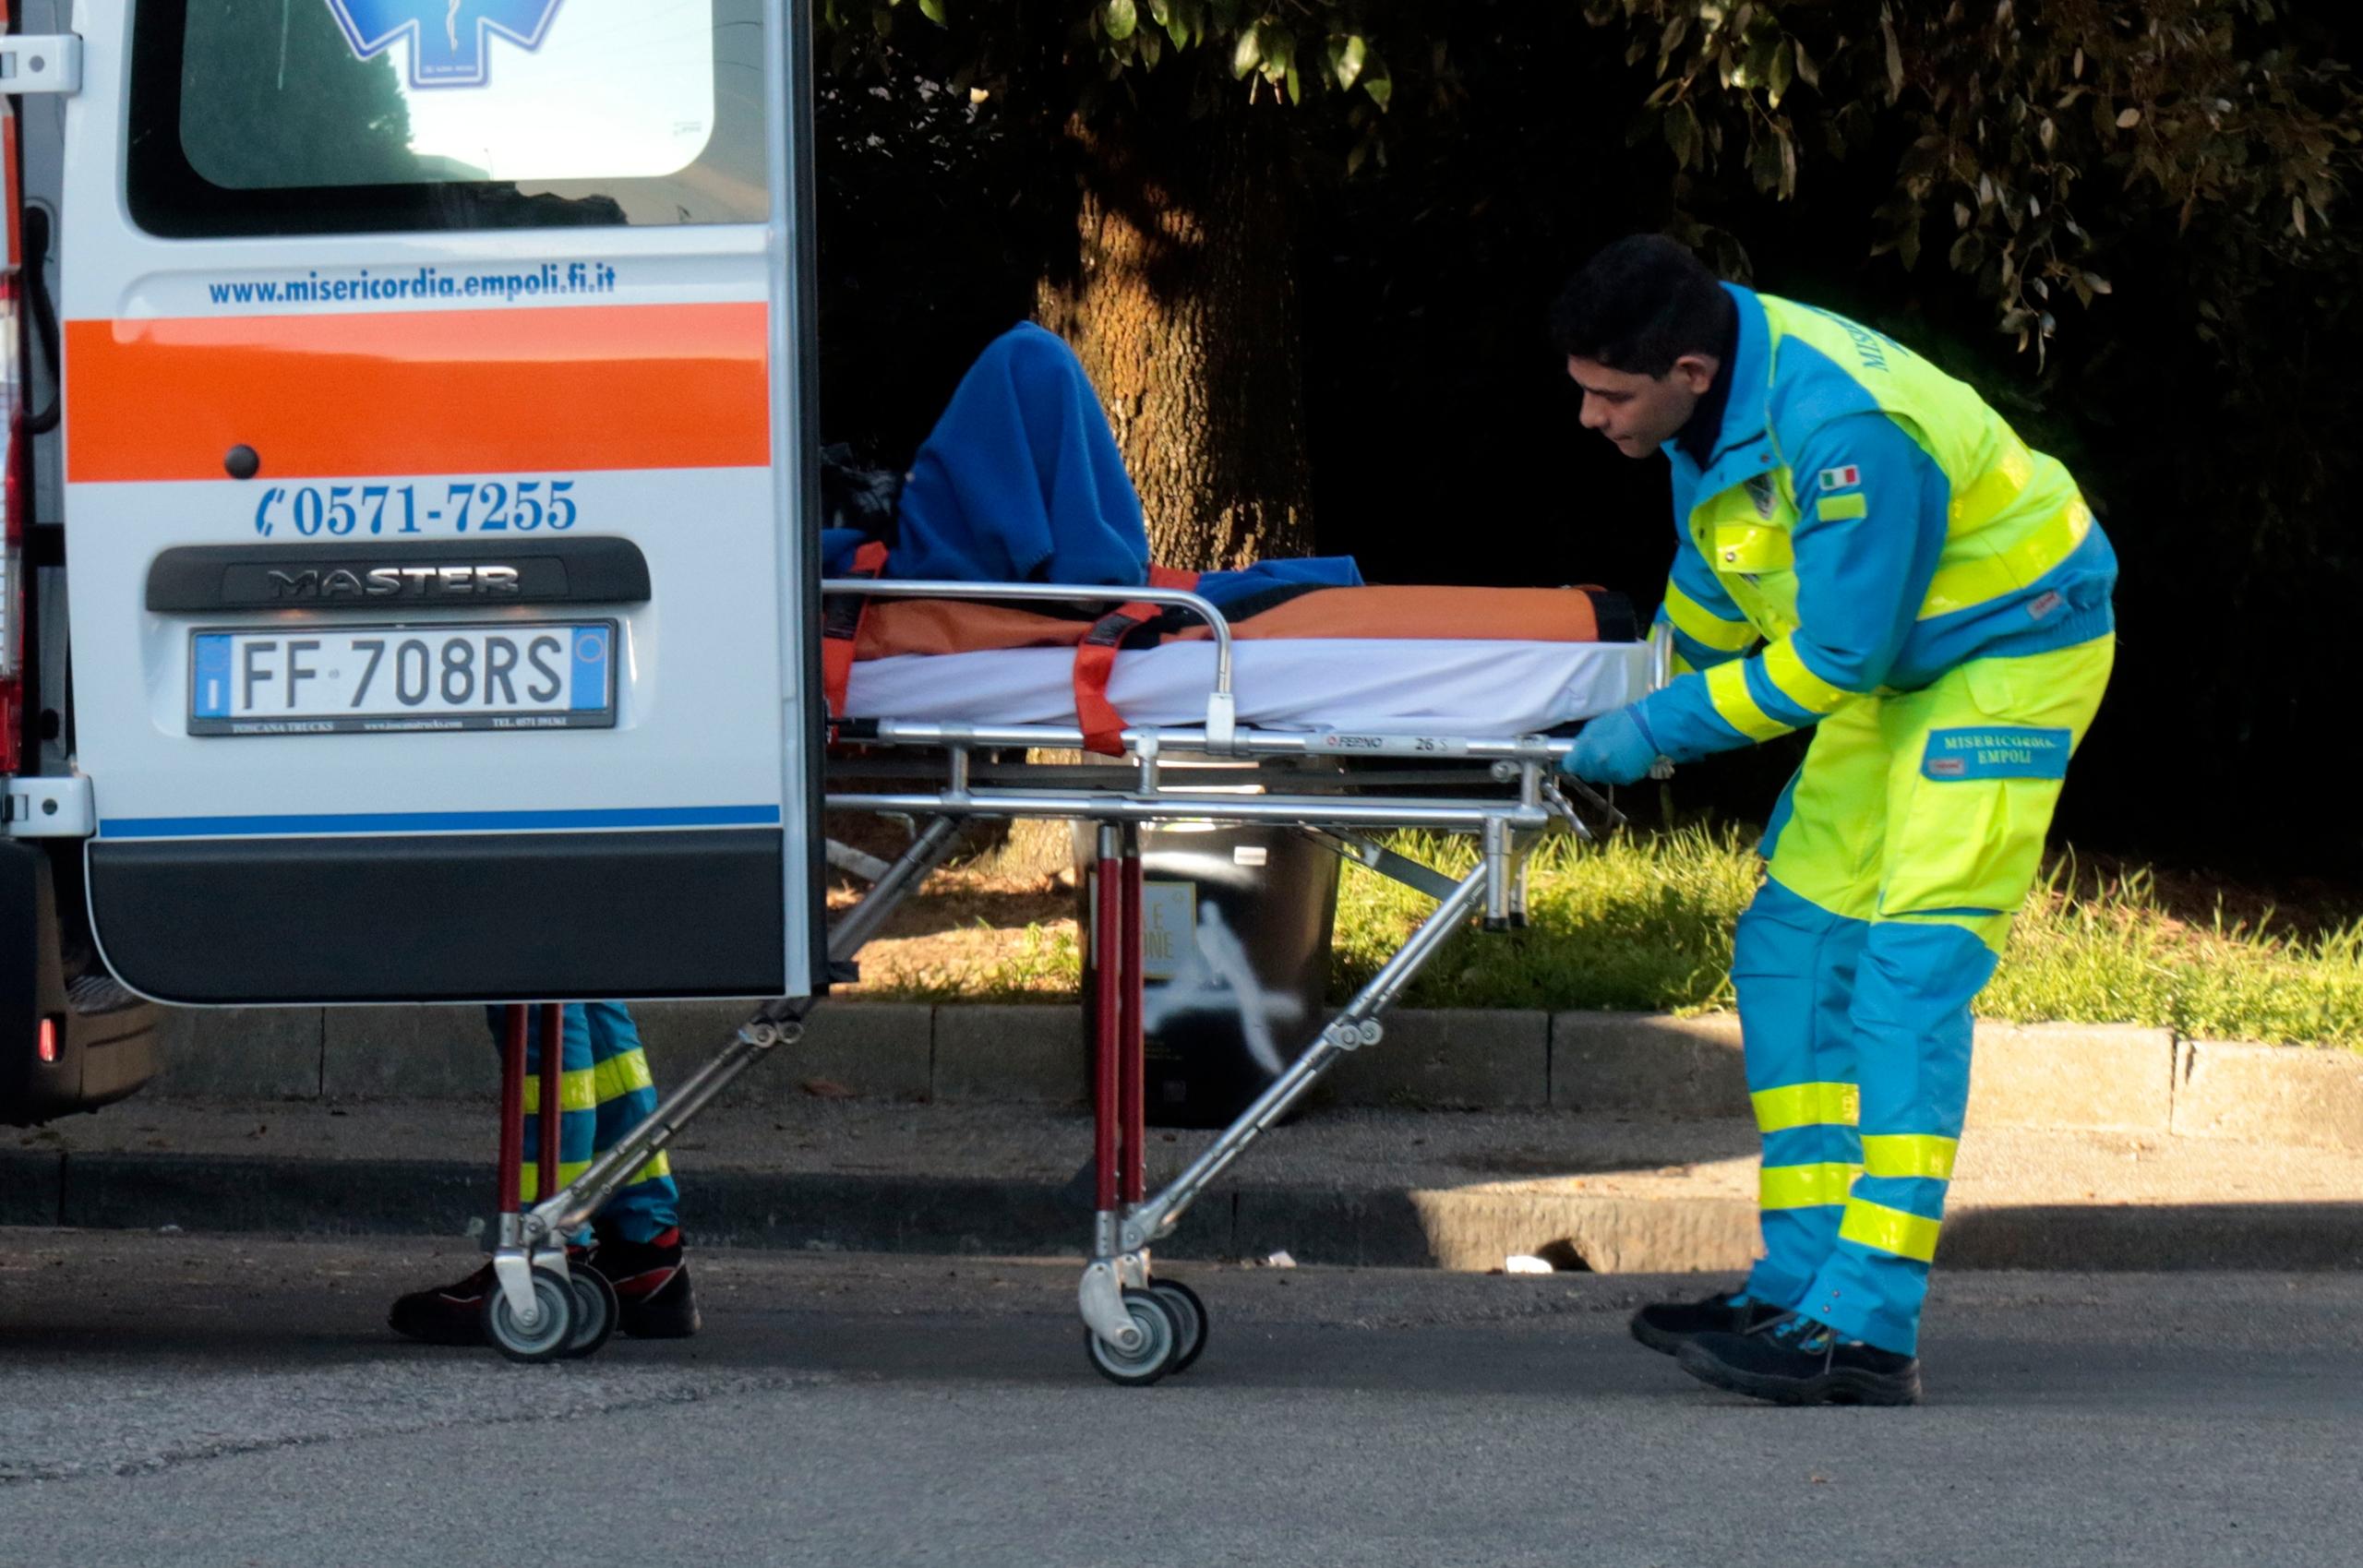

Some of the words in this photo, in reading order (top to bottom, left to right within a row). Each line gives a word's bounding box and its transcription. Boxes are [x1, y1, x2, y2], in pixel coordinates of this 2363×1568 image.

[209, 262, 616, 304] www.misericordia.empoli.fi.it
[293, 480, 577, 536] 0571-7255
[267, 565, 520, 597] MASTER
[1415, 737, 1434, 751] 26
[1978, 749, 2031, 764] EMPOLI
